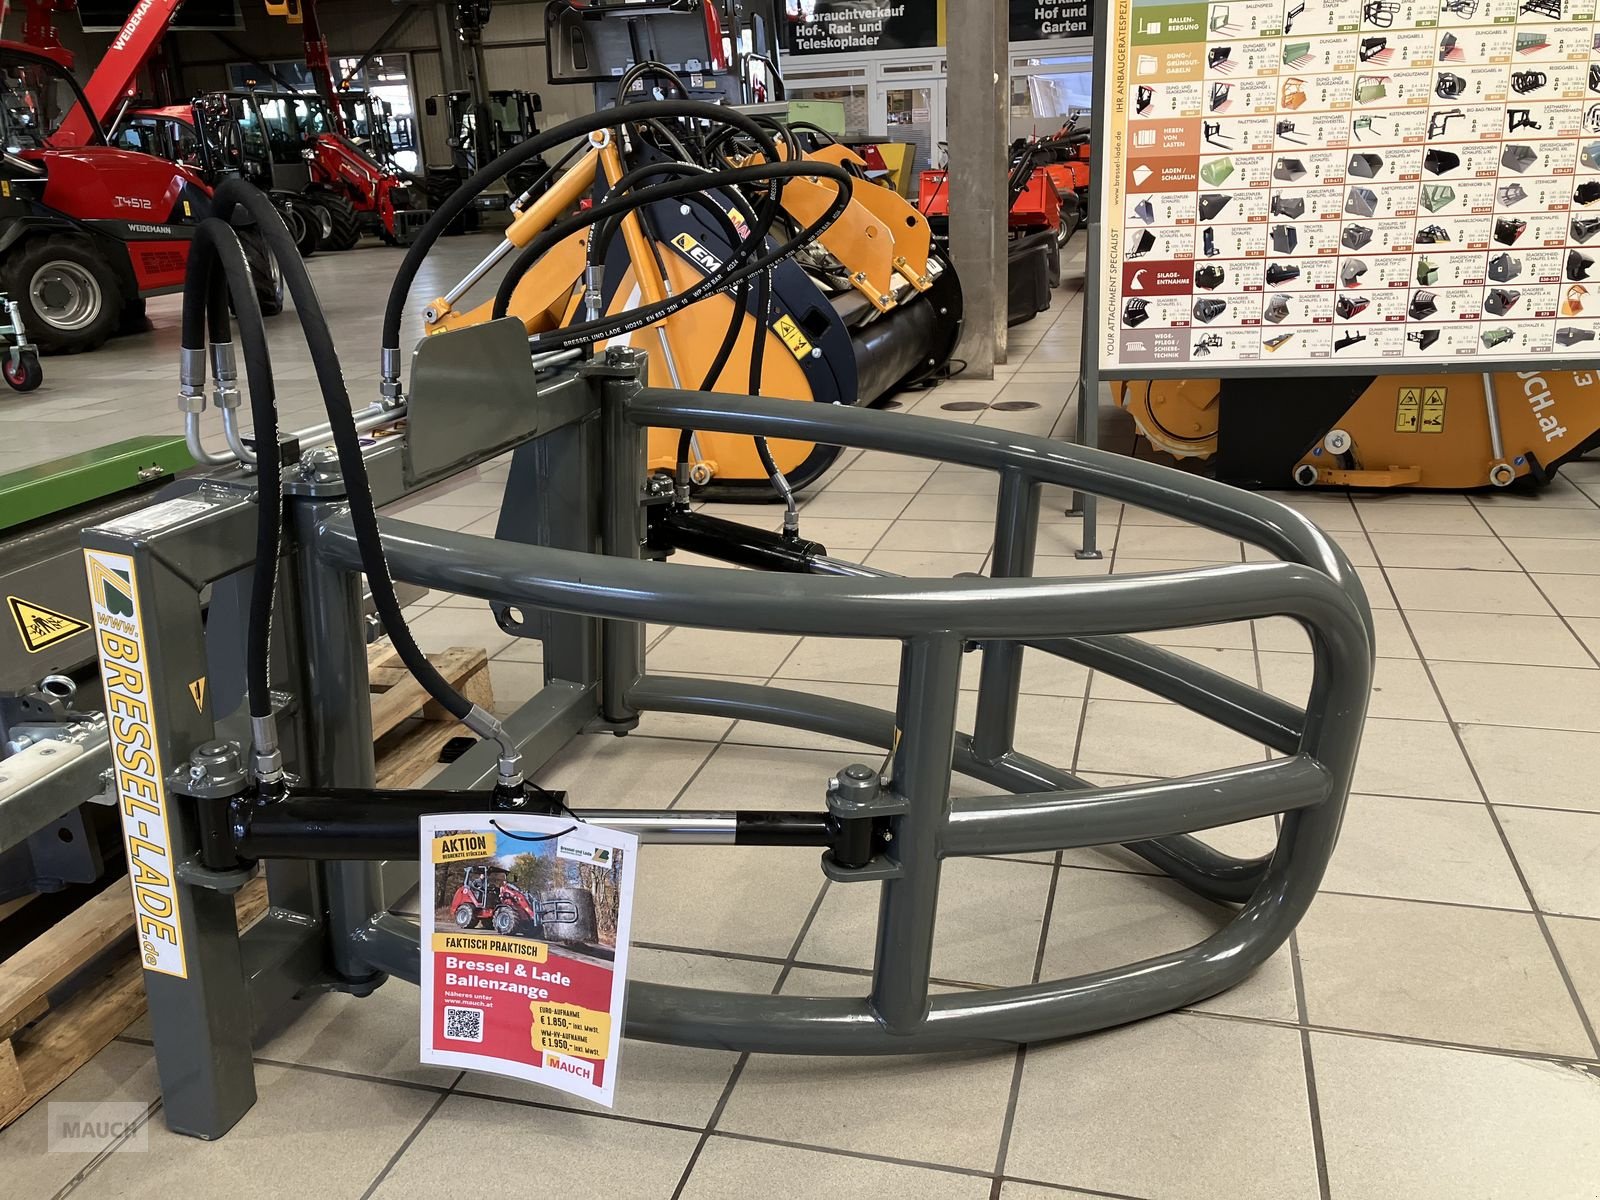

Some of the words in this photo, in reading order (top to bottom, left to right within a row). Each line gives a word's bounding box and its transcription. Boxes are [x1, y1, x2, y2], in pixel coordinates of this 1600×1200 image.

[1034, 7, 1059, 20] Hof
[1062, 5, 1087, 18] und
[796, 25, 826, 37] Hof-,
[828, 22, 856, 35] Rad-
[859, 20, 882, 32] und
[1041, 21, 1087, 34] Garten
[1168, 23, 1199, 31] BERGUNG
[796, 35, 880, 50] Teleskoplader
[1166, 59, 1200, 67] GRÜNGUT-
[1166, 66, 1191, 74] GABELN
[1115, 97, 1124, 113] IHR
[1163, 140, 1186, 148] LASTEN
[1113, 130, 1122, 206] www.bressel-lade.de
[1161, 173, 1196, 181] SCHAUFELN
[127, 223, 172, 235] WEIDEMANN
[1109, 228, 1119, 278] SPECIALIST
[563, 336, 591, 347] BRESSEL
[591, 331, 605, 341] UND
[604, 327, 622, 337] LADE
[645, 315, 655, 323] EN
[692, 287, 702, 299] WP
[710, 273, 723, 285] BAR
[1108, 277, 1117, 333] ATTACHMENT
[1106, 334, 1115, 356] YOUR
[441, 836, 487, 854] AKTION
[445, 937, 488, 950] FAKTISCH
[489, 942, 538, 957] PRAKTISCH
[445, 956, 510, 975] Bressel
[513, 964, 528, 978] &
[531, 967, 571, 988] Lade
[445, 973, 549, 1000] Ballenzange
[444, 990, 473, 999] Näheres
[444, 998, 494, 1008] www.mauch.at
[539, 1006, 580, 1019] EURO-AUFNAHME
[541, 1015, 545, 1025] €
[547, 1016, 572, 1030] 1.850,-
[542, 1037, 547, 1047] €
[548, 1037, 573, 1051] 1.950,-
[549, 1058, 591, 1080] MAUCH
